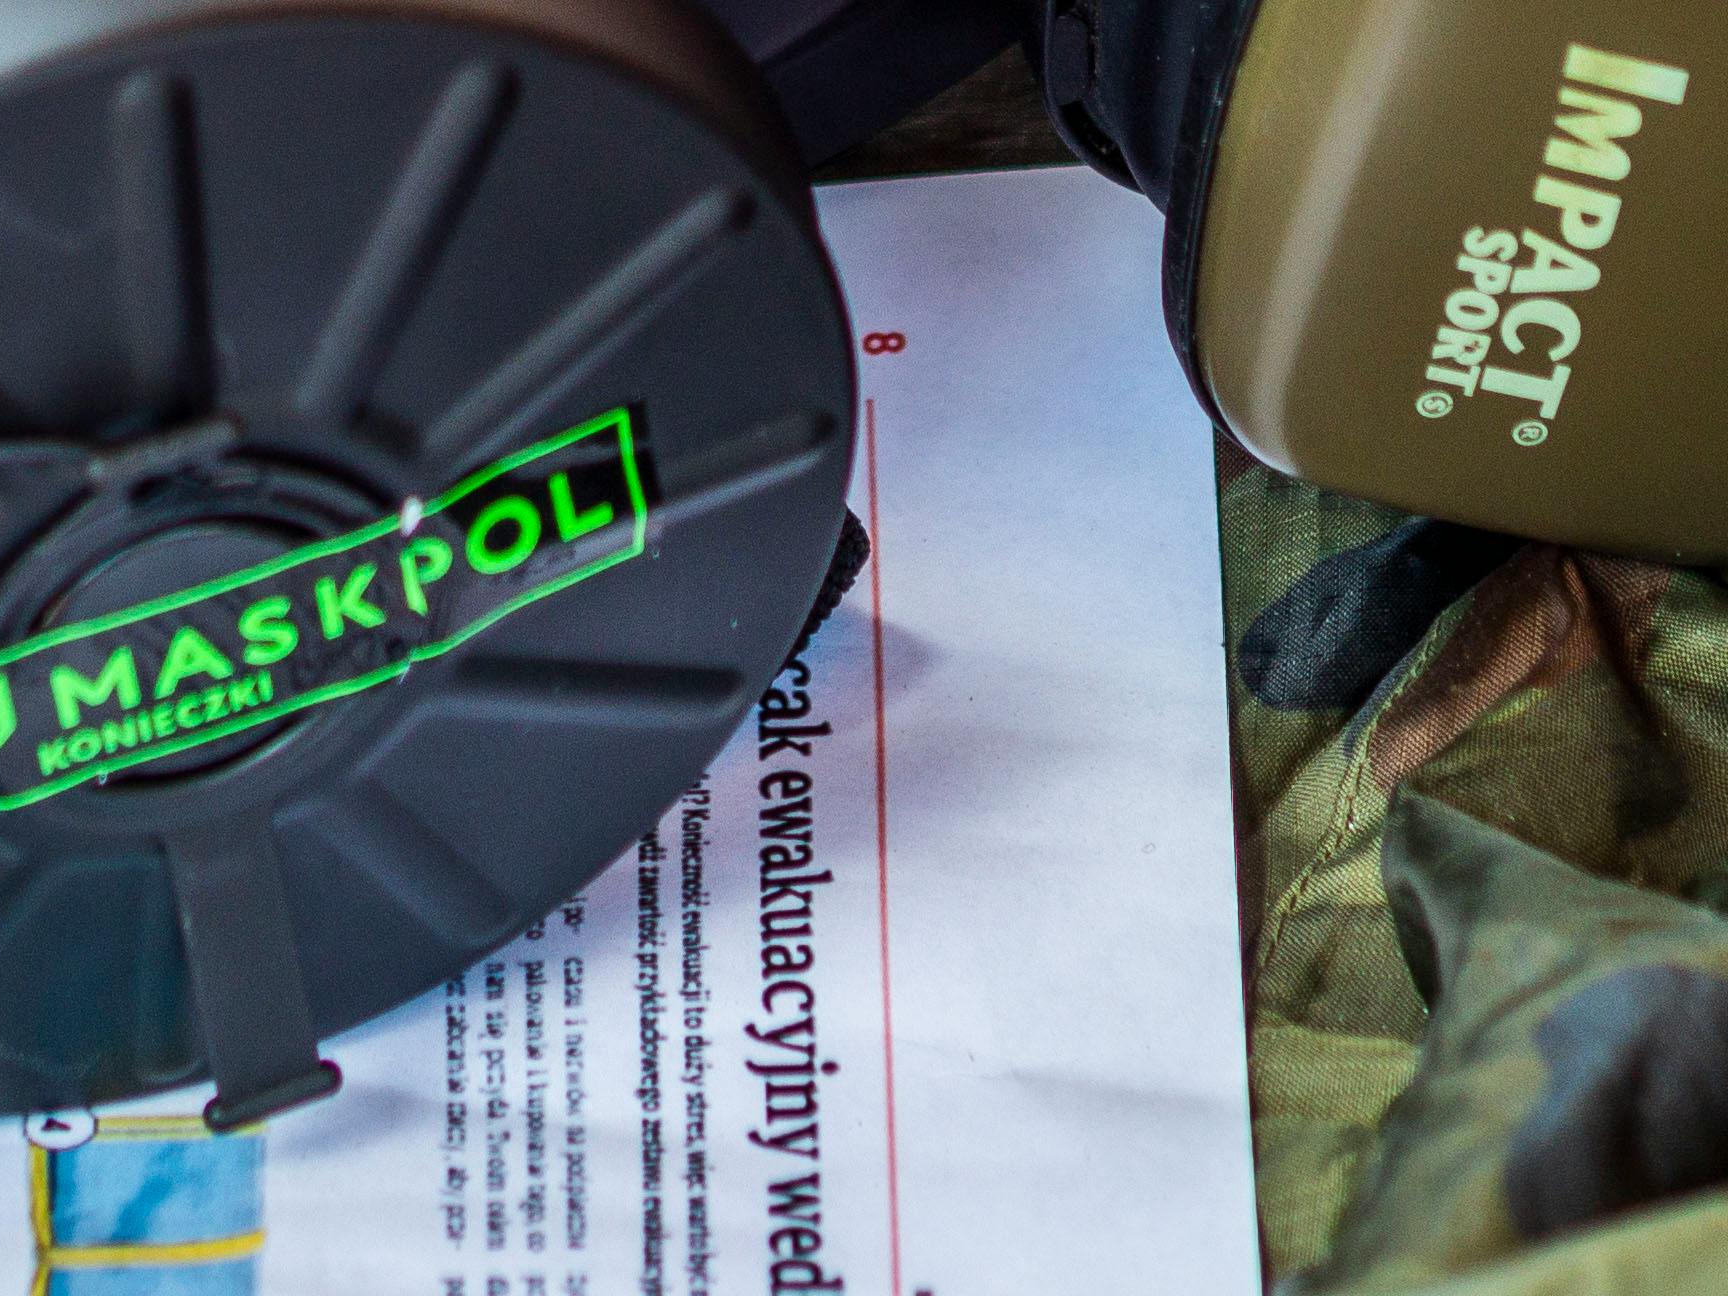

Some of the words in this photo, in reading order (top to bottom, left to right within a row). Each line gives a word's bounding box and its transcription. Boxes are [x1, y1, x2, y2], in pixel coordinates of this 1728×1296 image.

[862, 330, 907, 356] 8
[50, 472, 615, 730] MASKPOL
[37, 670, 273, 777] KONIECZKI
[638, 864, 664, 948] zawartość
[681, 808, 710, 909] Konieczność
[680, 911, 712, 1001] ewakuacji
[745, 770, 841, 1162] ewakuacyjny
[633, 951, 666, 1113] przykładowego
[682, 1035, 710, 1087] duży
[684, 1007, 705, 1030] to
